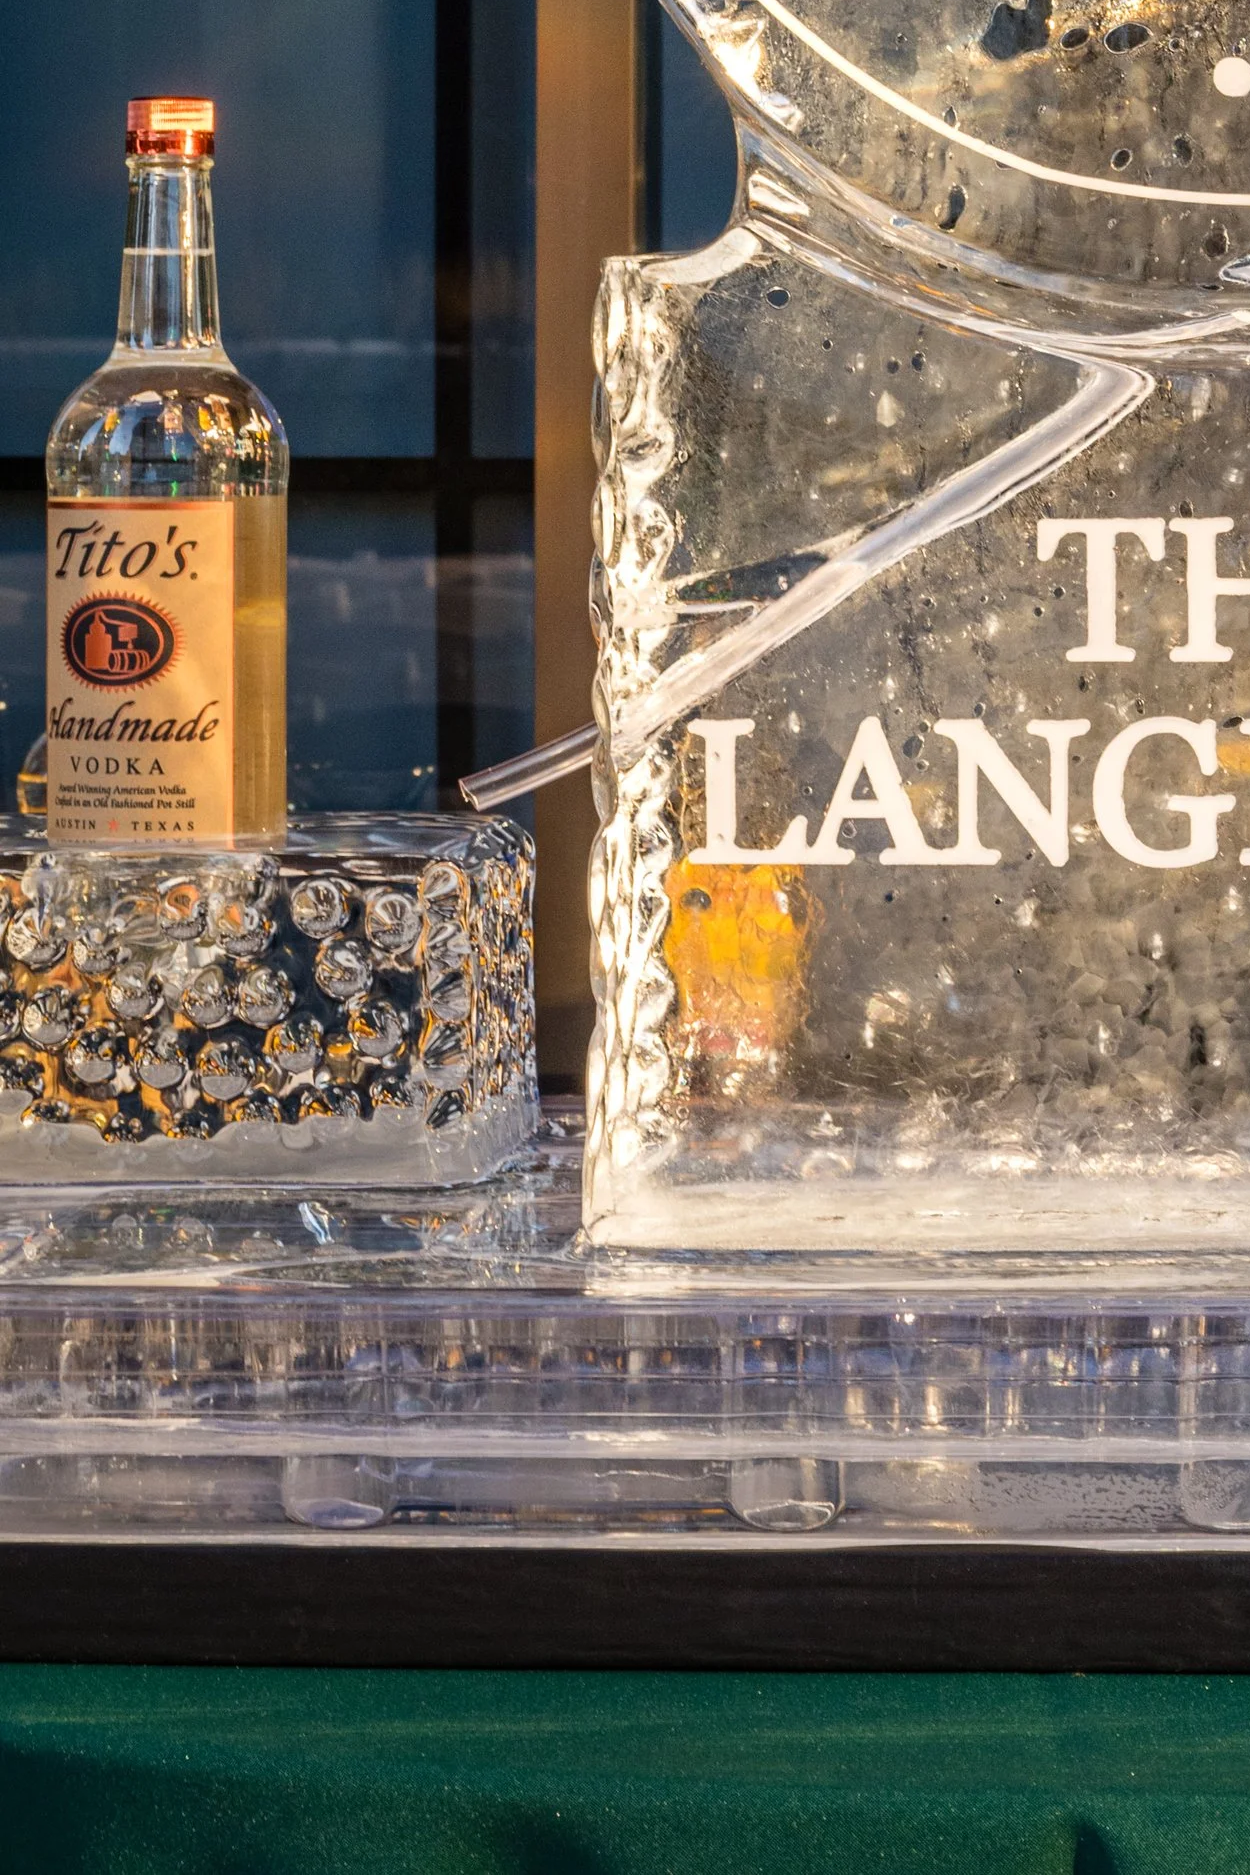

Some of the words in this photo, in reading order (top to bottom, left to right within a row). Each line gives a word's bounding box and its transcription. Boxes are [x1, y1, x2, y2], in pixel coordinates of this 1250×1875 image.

[55, 520, 198, 579] Tito's
[50, 696, 220, 743] Handmade
[70, 755, 165, 775] VODKA
[76, 783, 111, 798] Winning
[113, 785, 156, 795] American
[158, 785, 187, 795] Vodka
[93, 796, 108, 808] Old
[110, 798, 154, 809] Fashioned
[157, 798, 172, 809] Pot
[174, 797, 196, 809] Still
[55, 818, 96, 830] AUSTIN
[131, 820, 195, 832] TEXAS
